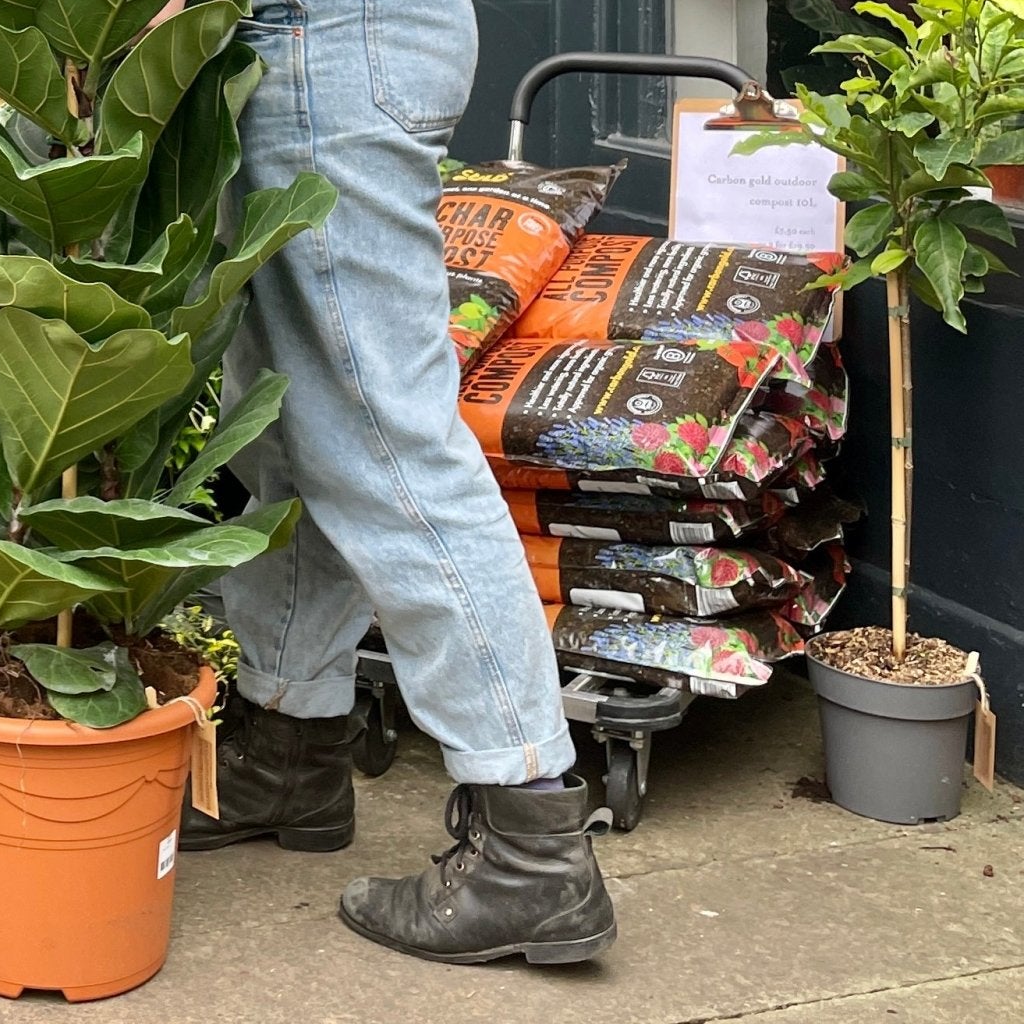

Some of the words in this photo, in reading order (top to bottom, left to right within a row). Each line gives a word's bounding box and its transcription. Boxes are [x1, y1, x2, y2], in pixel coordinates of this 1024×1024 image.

[707, 174, 746, 185] Carbon
[749, 175, 771, 188] gold
[774, 176, 817, 186] outdoor
[436, 201, 514, 231] CHAR
[749, 198, 792, 209] compost
[439, 223, 503, 249] RPOSE
[444, 245, 493, 269] OST
[542, 275, 576, 302] ALL
[670, 281, 690, 310] Approved
[463, 342, 549, 404] COMPOST
[566, 383, 591, 413] Approved
